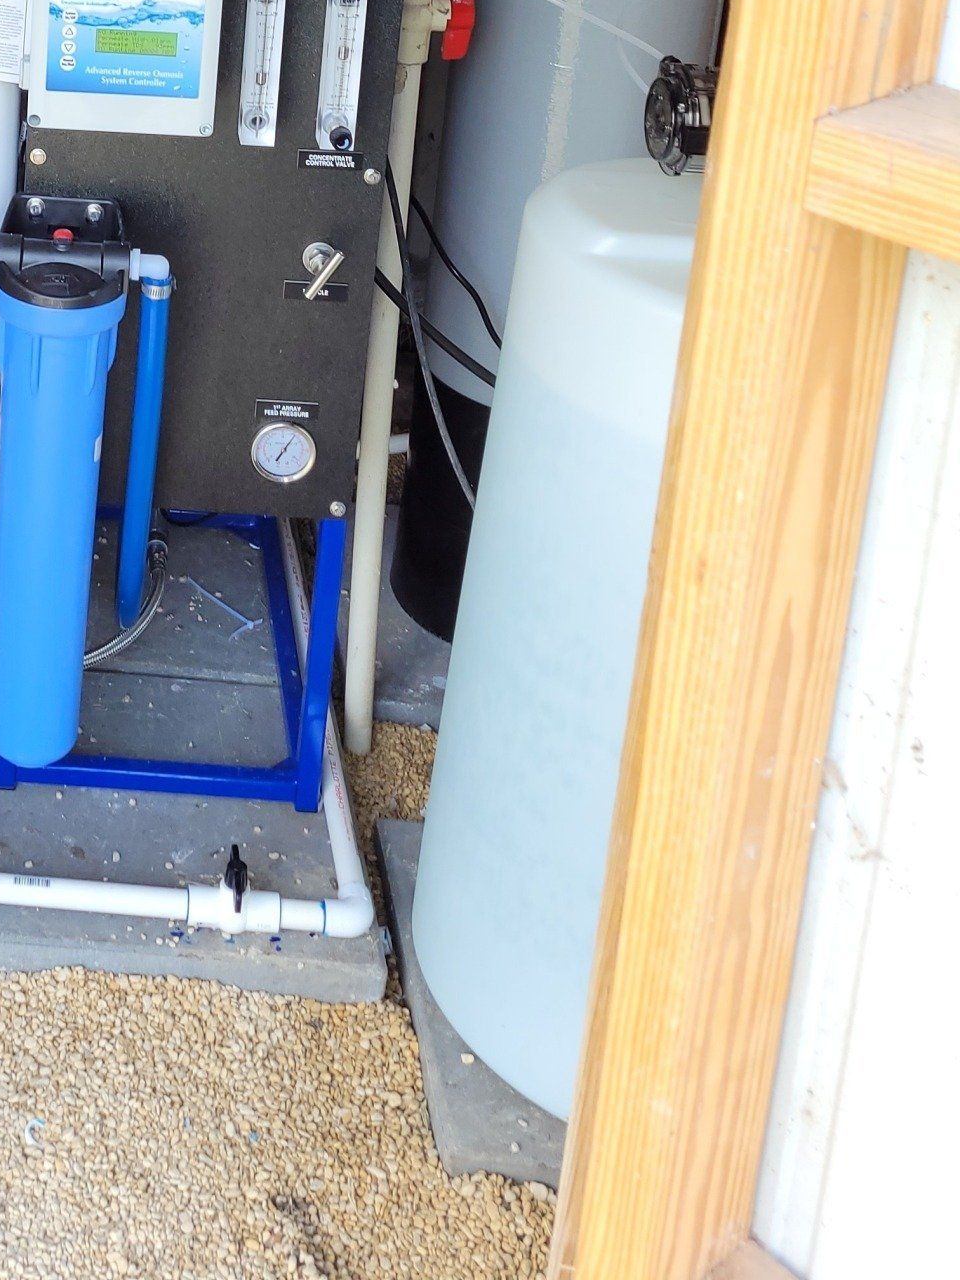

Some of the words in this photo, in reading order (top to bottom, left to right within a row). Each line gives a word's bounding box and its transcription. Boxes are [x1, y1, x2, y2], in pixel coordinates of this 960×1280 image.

[85, 66, 121, 76] Advanced
[123, 68, 151, 77] Reverse
[153, 69, 184, 79] Osmosis
[100, 76, 127, 86] System
[128, 77, 167, 88] Controller
[309, 153, 353, 162] CONCENTRATE
[305, 159, 334, 167] CONTROL
[335, 160, 355, 168] VALVE
[280, 410, 310, 418] PRESSURE
